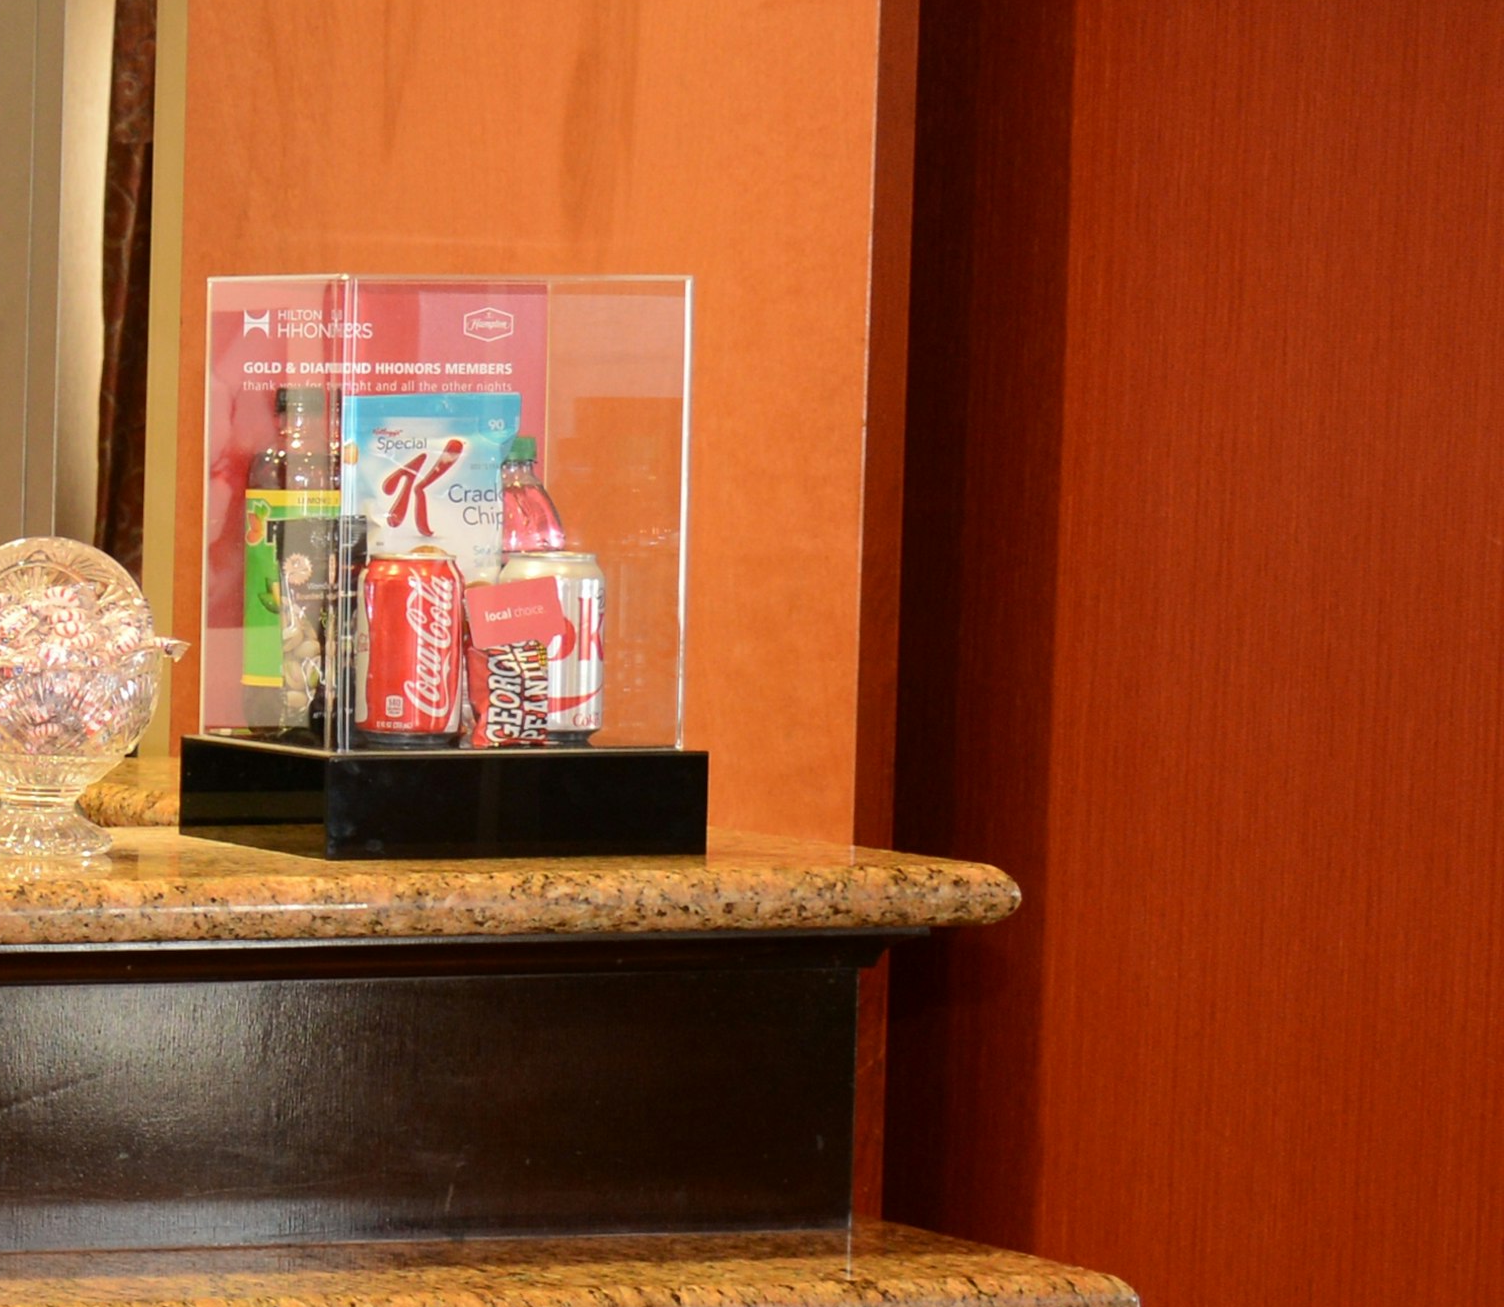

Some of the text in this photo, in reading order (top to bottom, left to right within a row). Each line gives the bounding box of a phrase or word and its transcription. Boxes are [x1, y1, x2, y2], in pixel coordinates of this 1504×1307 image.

[277, 309, 322, 321] HILTON
[243, 362, 282, 375] GOLD
[285, 362, 297, 375] &
[375, 363, 441, 375] HHONORS
[445, 363, 513, 375] MEMBERS
[243, 380, 276, 391] thank
[375, 380, 397, 392] and
[400, 380, 415, 392] all
[418, 380, 438, 392] the
[441, 380, 473, 392] other
[476, 380, 513, 393] nights
[488, 419, 505, 431] 90
[376, 436, 428, 454] Special
[381, 438, 464, 537] K
[484, 607, 512, 623] local
